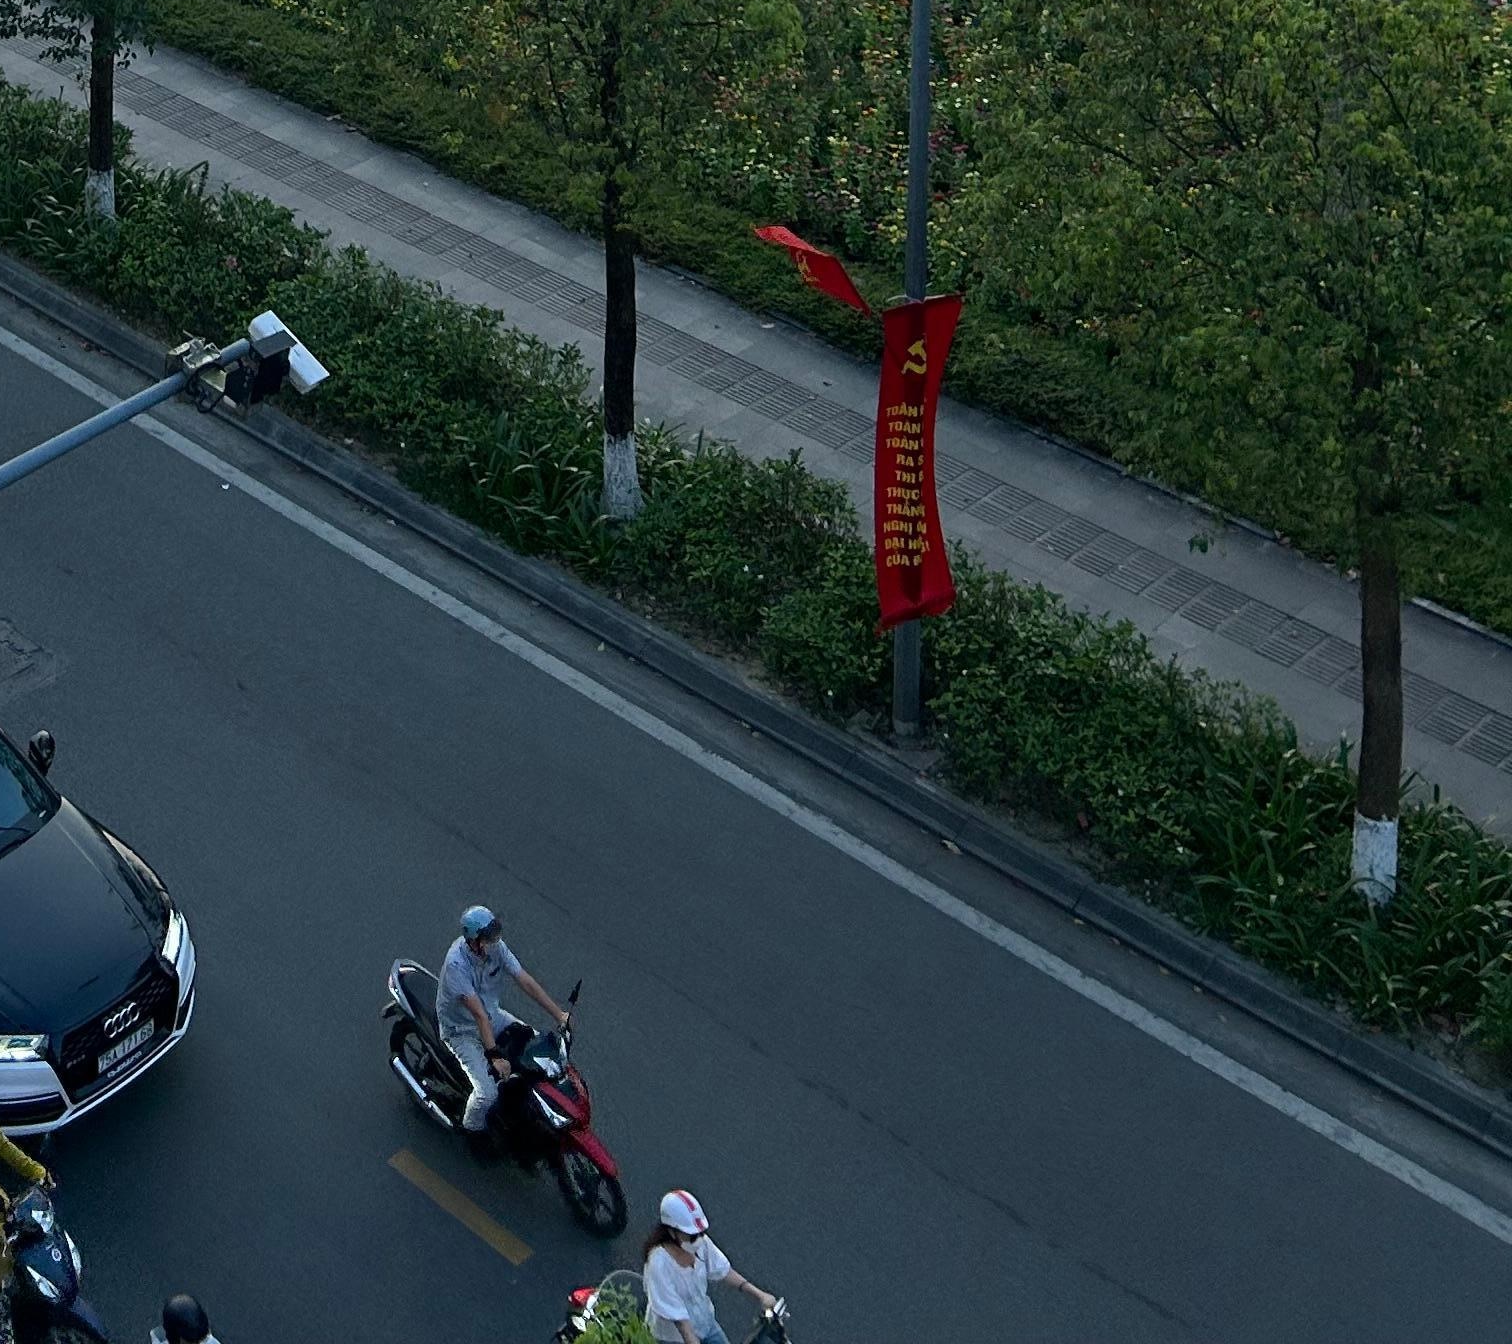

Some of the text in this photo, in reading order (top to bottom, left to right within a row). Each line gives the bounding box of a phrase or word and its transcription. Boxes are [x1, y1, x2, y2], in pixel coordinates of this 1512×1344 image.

[886, 402, 918, 417] TOÀN
[885, 435, 919, 450] TOÀN
[896, 453, 914, 467] RA
[895, 470, 916, 484] THI
